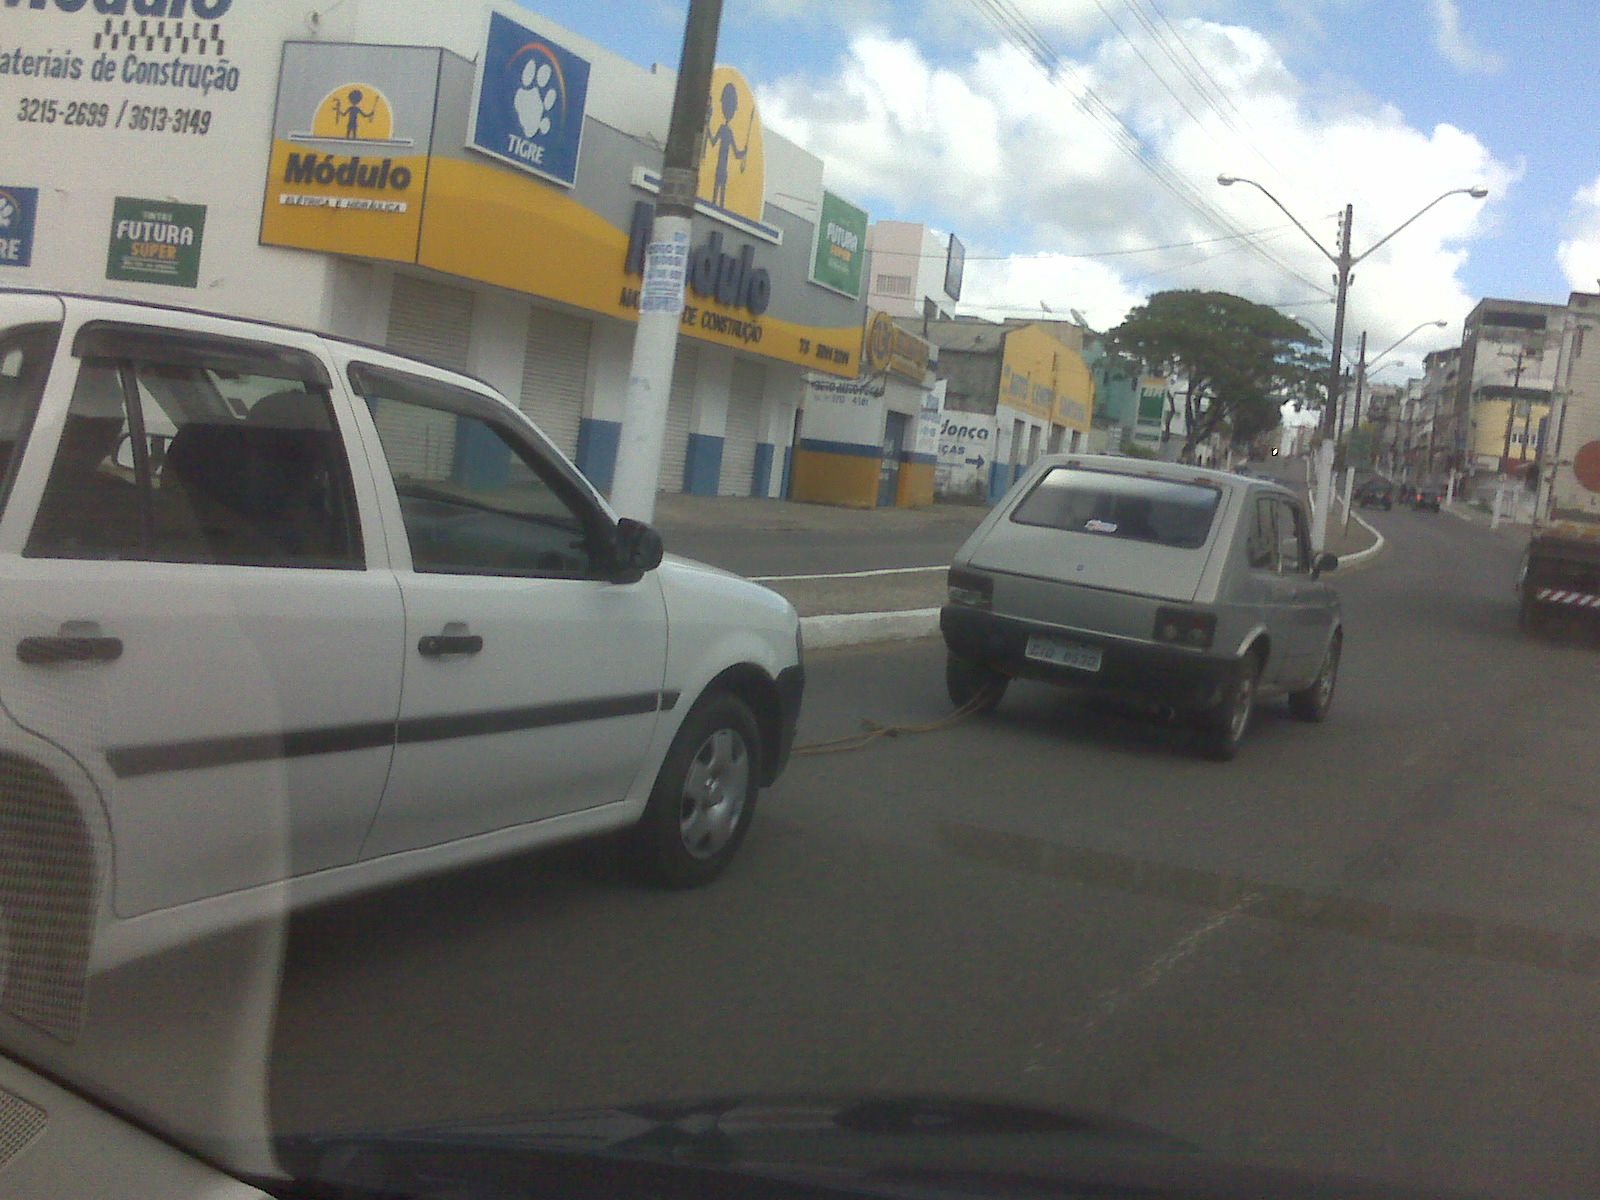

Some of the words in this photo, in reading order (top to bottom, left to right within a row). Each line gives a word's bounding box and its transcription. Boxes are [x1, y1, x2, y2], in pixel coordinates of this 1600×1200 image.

[91, 53, 117, 83] de
[122, 53, 240, 96] Construção
[17, 98, 110, 128] 3215-2699
[129, 105, 213, 135] 3613-3149
[508, 134, 546, 164] TIGRE
[284, 153, 412, 190] Módulo
[116, 219, 194, 246] FUTURA
[130, 242, 178, 260] SUPER
[682, 305, 698, 325] DE
